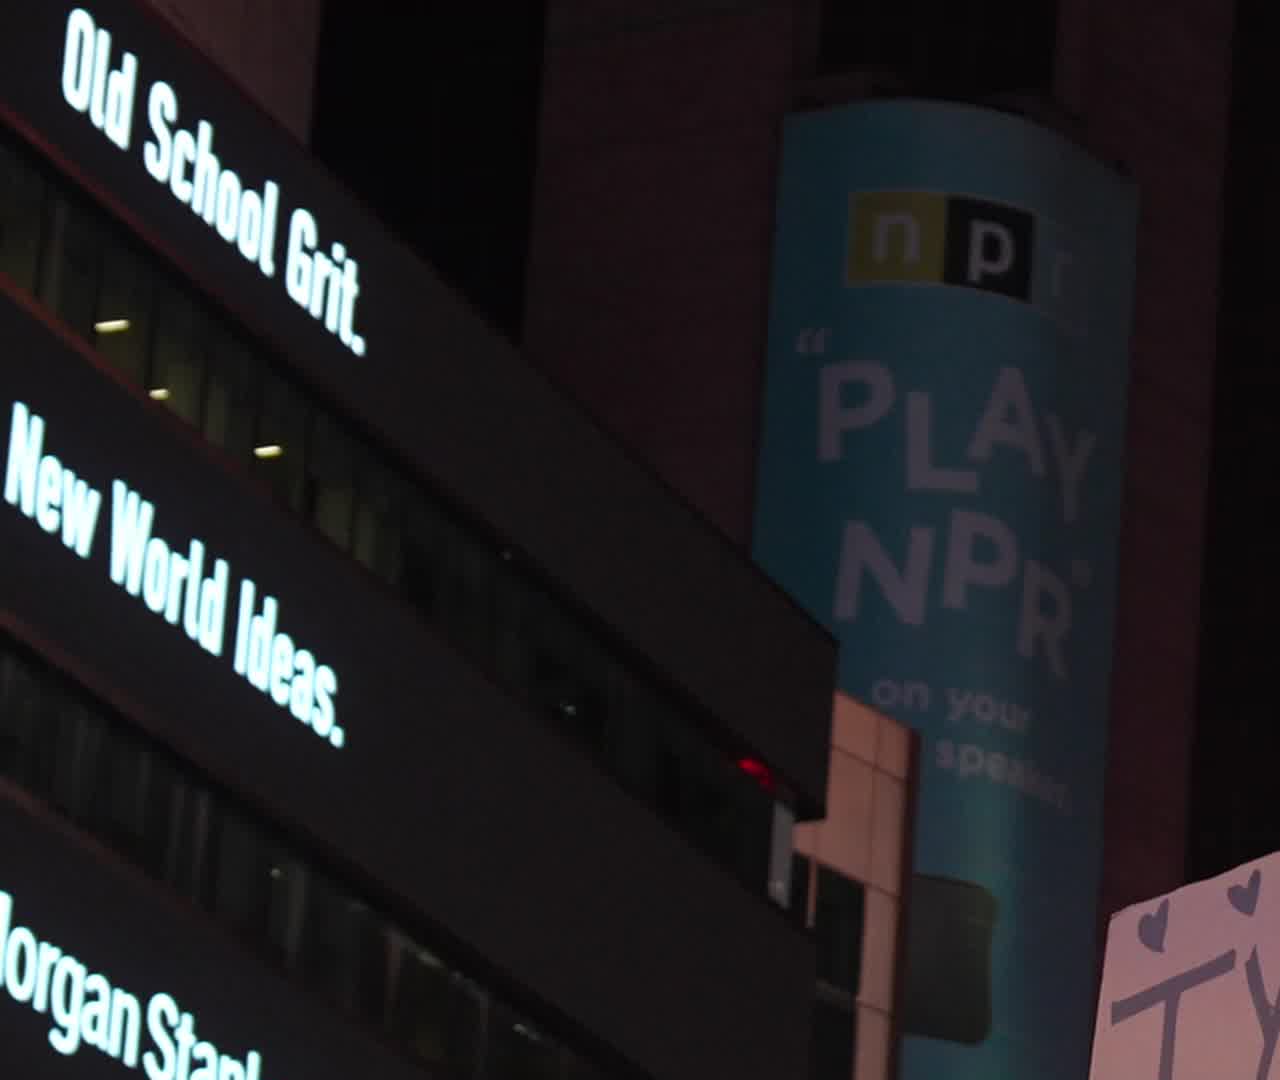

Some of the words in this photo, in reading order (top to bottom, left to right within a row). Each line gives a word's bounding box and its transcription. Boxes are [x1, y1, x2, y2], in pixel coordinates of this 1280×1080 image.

[62, 8, 137, 150] Old
[144, 81, 278, 277] School
[286, 208, 366, 356] Grit.
[4, 401, 101, 559] New
[110, 479, 230, 657] World
[234, 578, 345, 748] Ideas.
[871, 680, 929, 711] on
[945, 687, 1029, 731] your
[0, 889, 141, 1068] organ
